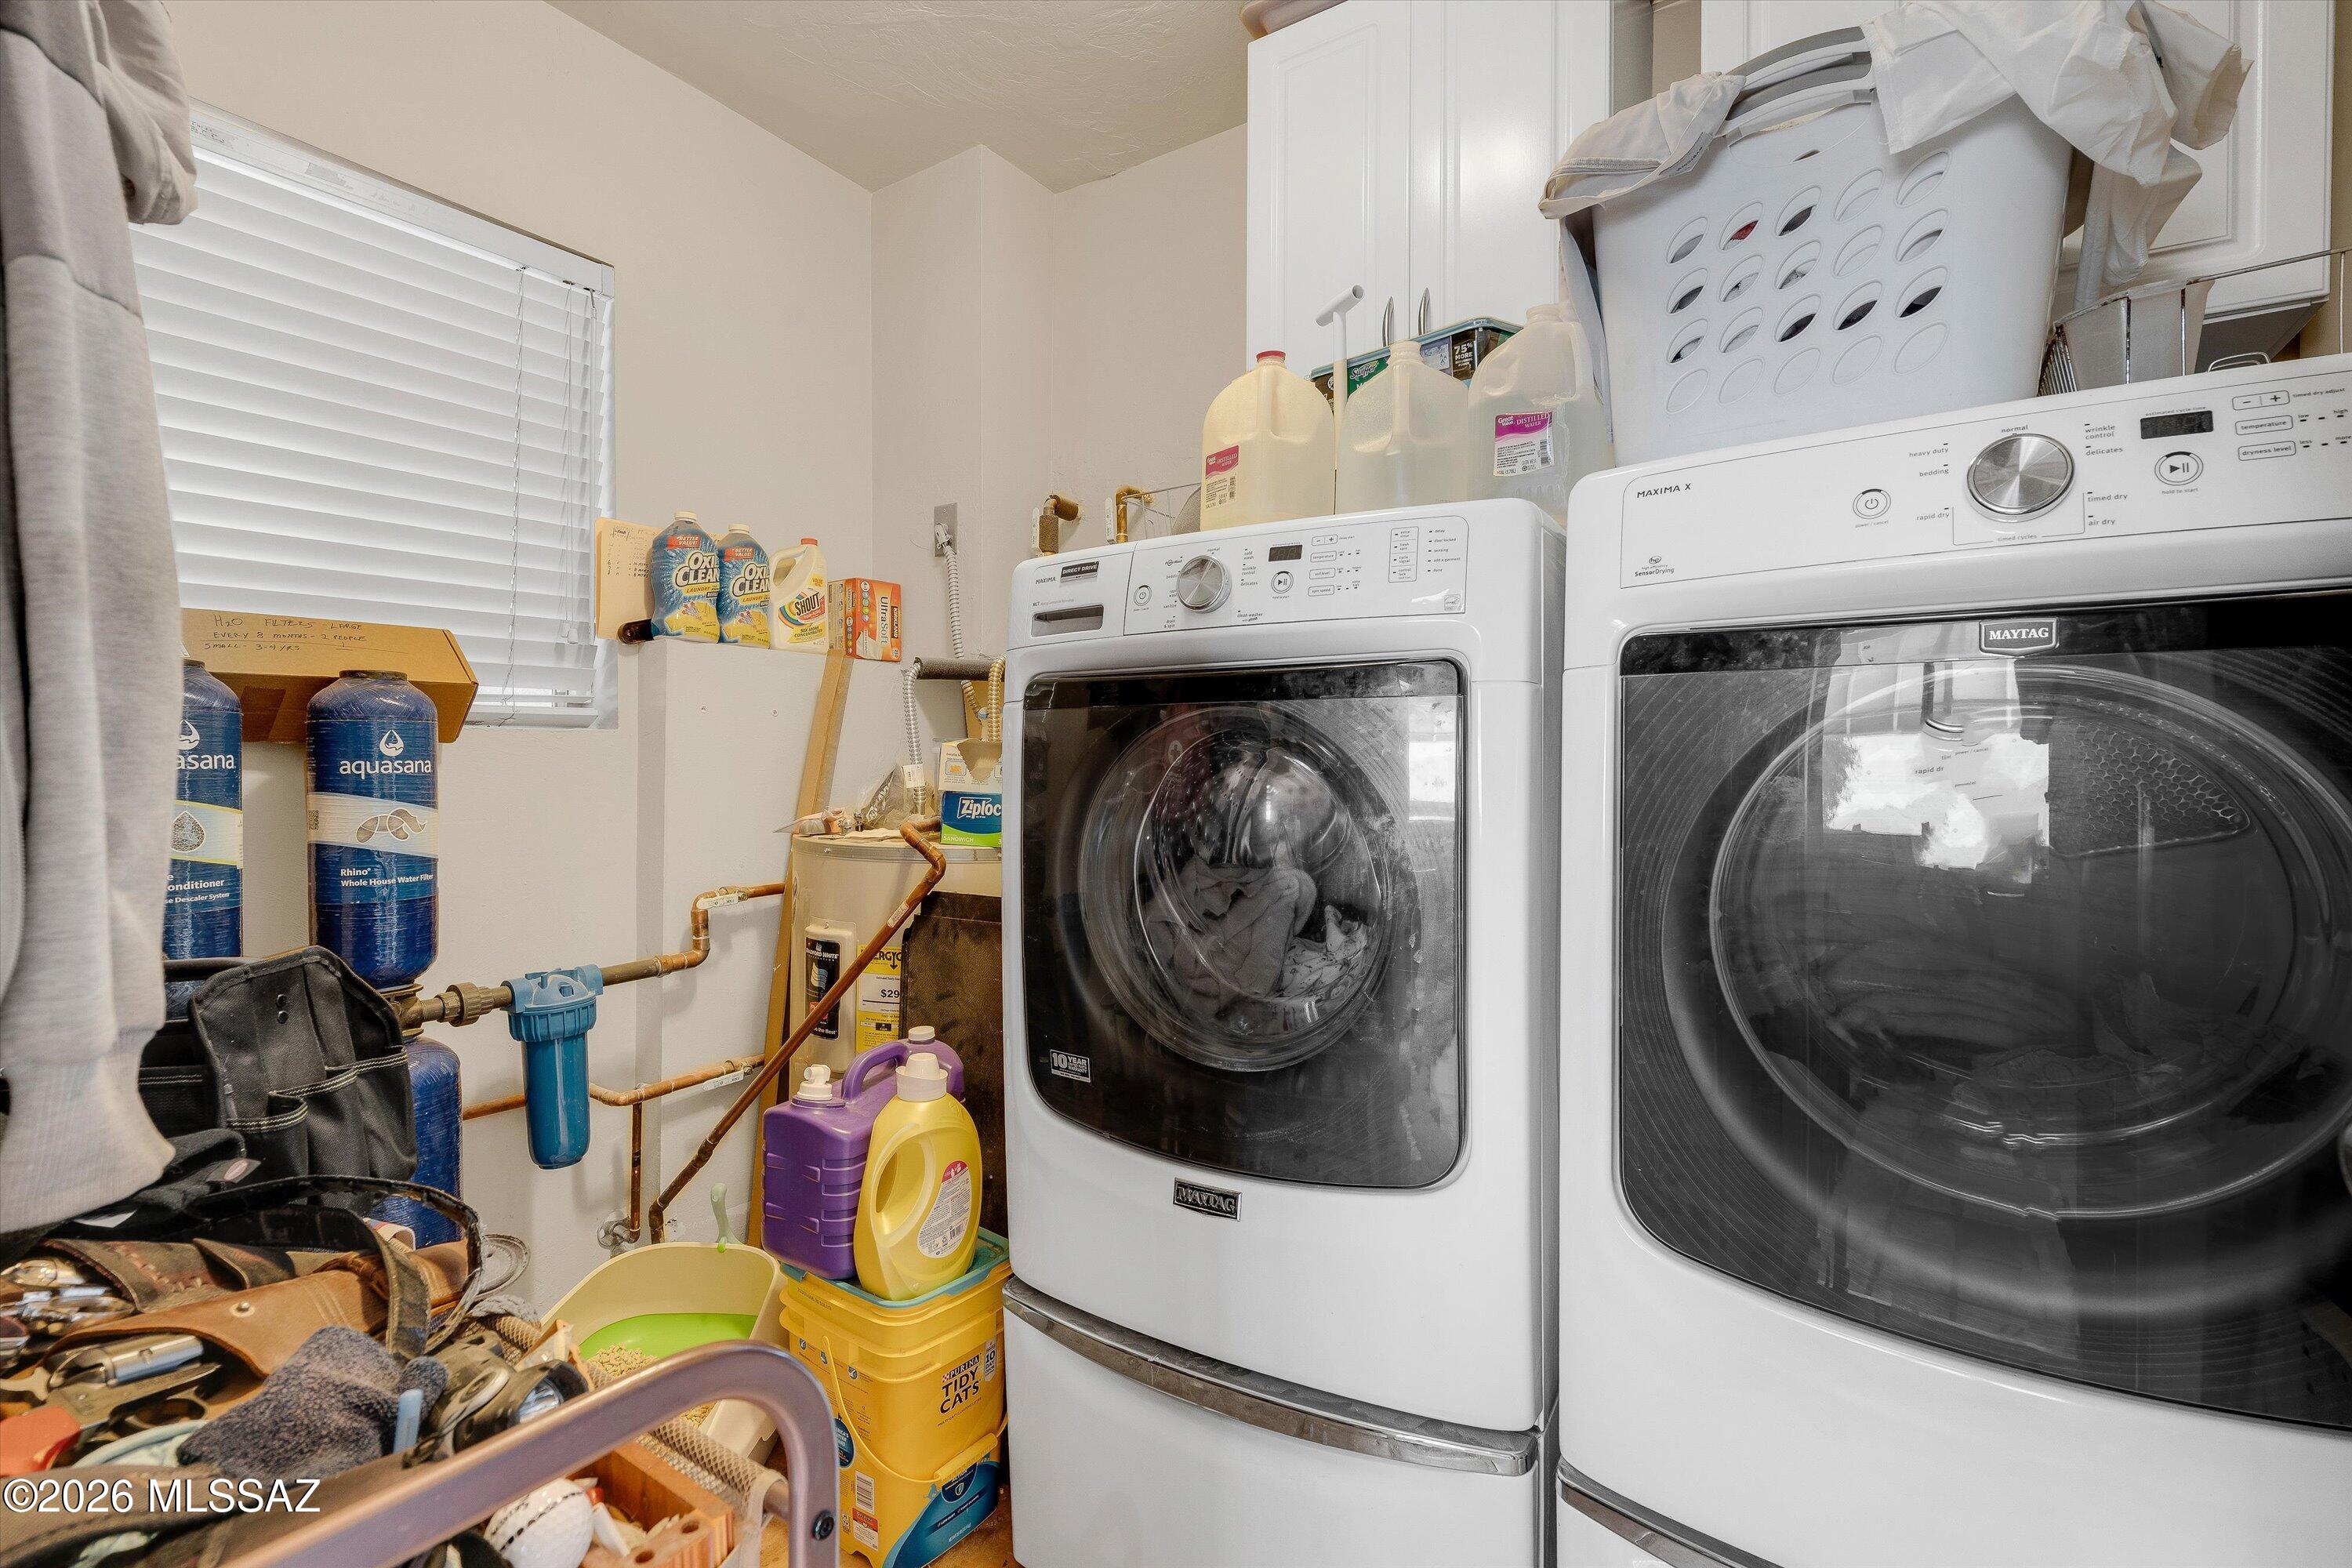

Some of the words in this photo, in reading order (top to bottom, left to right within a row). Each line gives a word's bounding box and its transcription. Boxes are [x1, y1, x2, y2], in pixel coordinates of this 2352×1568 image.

[1454, 343, 1472, 354] 75%
[1455, 352, 1472, 360] MORE
[1350, 365, 1376, 379] Swiffer
[1517, 414, 1550, 425] DISTILLED
[2241, 420, 2286, 430] temperature
[2001, 425, 2028, 433] normal
[1909, 450, 1930, 458] heavy
[1933, 446, 1949, 456] duty
[2085, 446, 2123, 456] delicates
[2242, 447, 2272, 456] dryness
[1919, 468, 1949, 477] bedding
[1637, 485, 1681, 498] MAXIMA
[2114, 494, 2128, 502] dry
[1916, 514, 1935, 522] rapid
[1936, 512, 1949, 520] dry
[2102, 518, 2115, 526] dry
[1635, 568, 1674, 577] SensorDrying
[795, 592, 819, 616] SHOUT
[1989, 627, 2049, 640] MAYTAG
[339, 760, 431, 779] aquasana
[961, 799, 1001, 818] Ziploc
[175, 895, 208, 904] Descaler
[209, 892, 229, 901] System
[881, 989, 900, 998] $29
[1053, 1053, 1067, 1068] 10
[1067, 1056, 1087, 1066] YEAR
[1178, 1187, 1235, 1213] MAYTAG
[986, 1350, 995, 1363] 10
[950, 1356, 979, 1378] PURINA
[942, 1366, 978, 1397] TIDY
[940, 1380, 979, 1414] CATS
